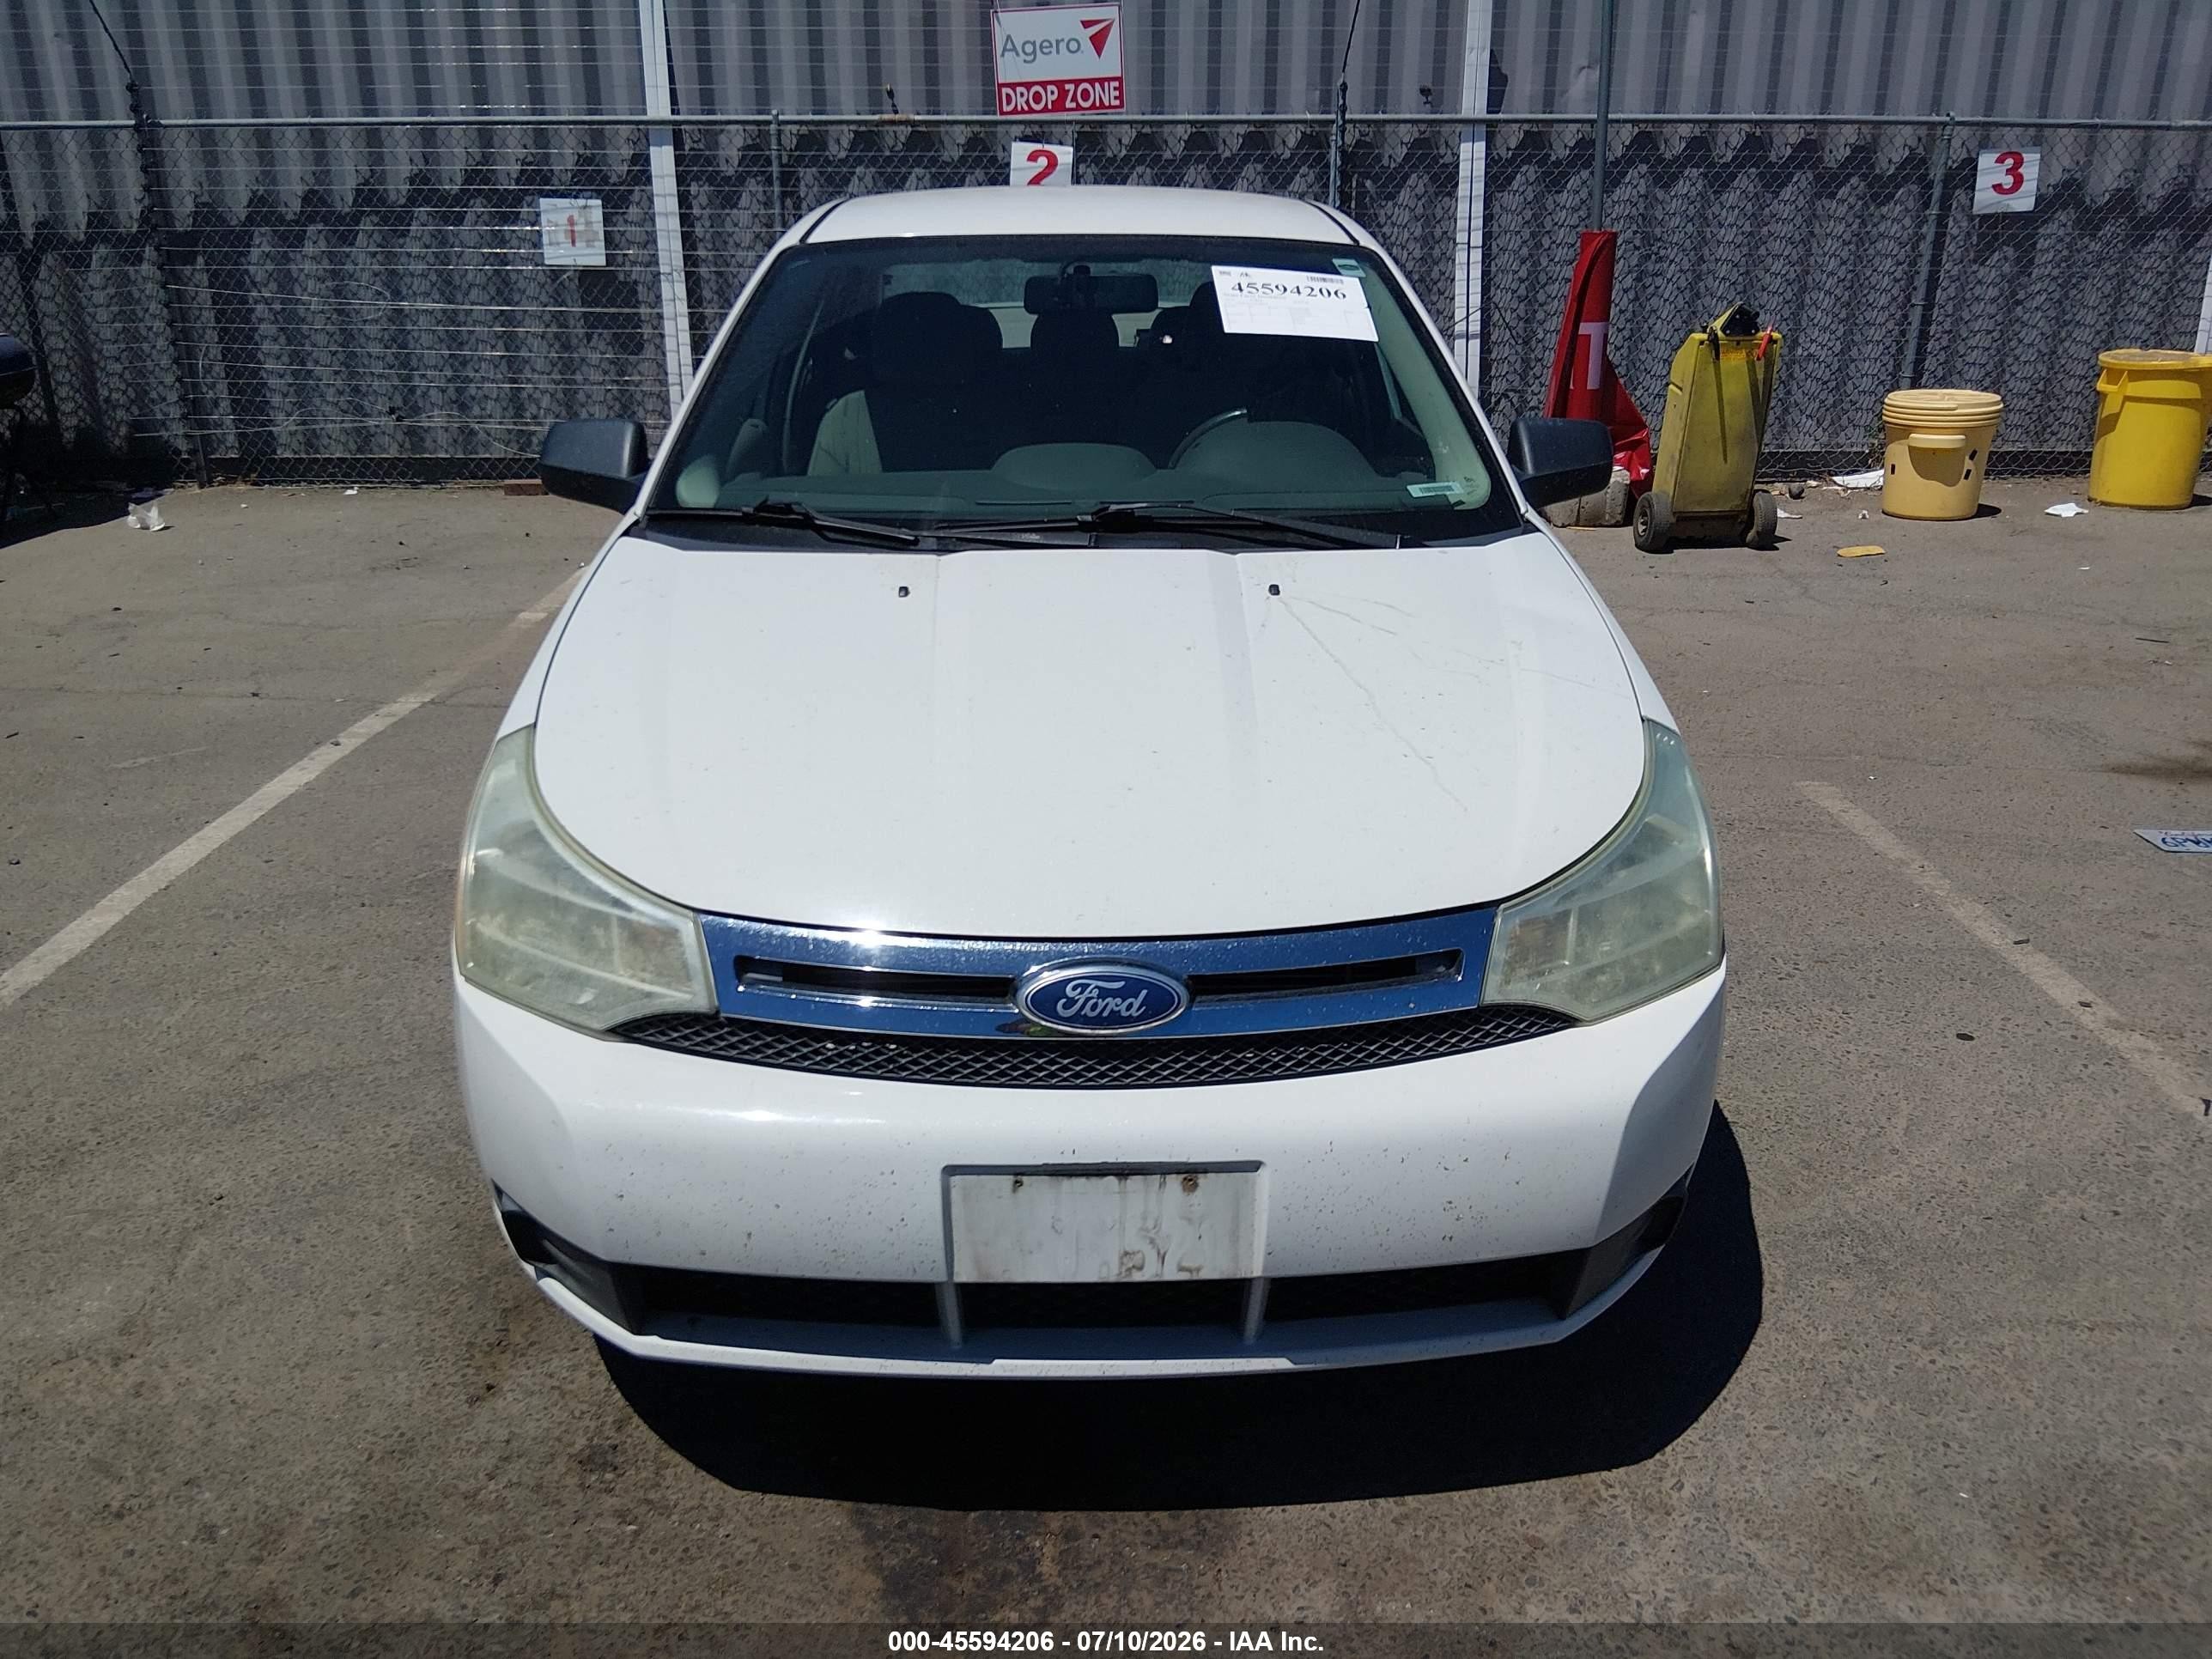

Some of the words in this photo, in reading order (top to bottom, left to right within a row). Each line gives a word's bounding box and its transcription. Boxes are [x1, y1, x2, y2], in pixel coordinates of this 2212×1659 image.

[1000, 33, 1082, 64] Agero
[1001, 84, 1059, 112] DROP
[1064, 81, 1121, 109] ZONE
[1026, 149, 1059, 186] 2
[1991, 150, 2025, 196] 3
[1231, 282, 1347, 301] 45594206
[1056, 979, 1148, 1018] Ford
